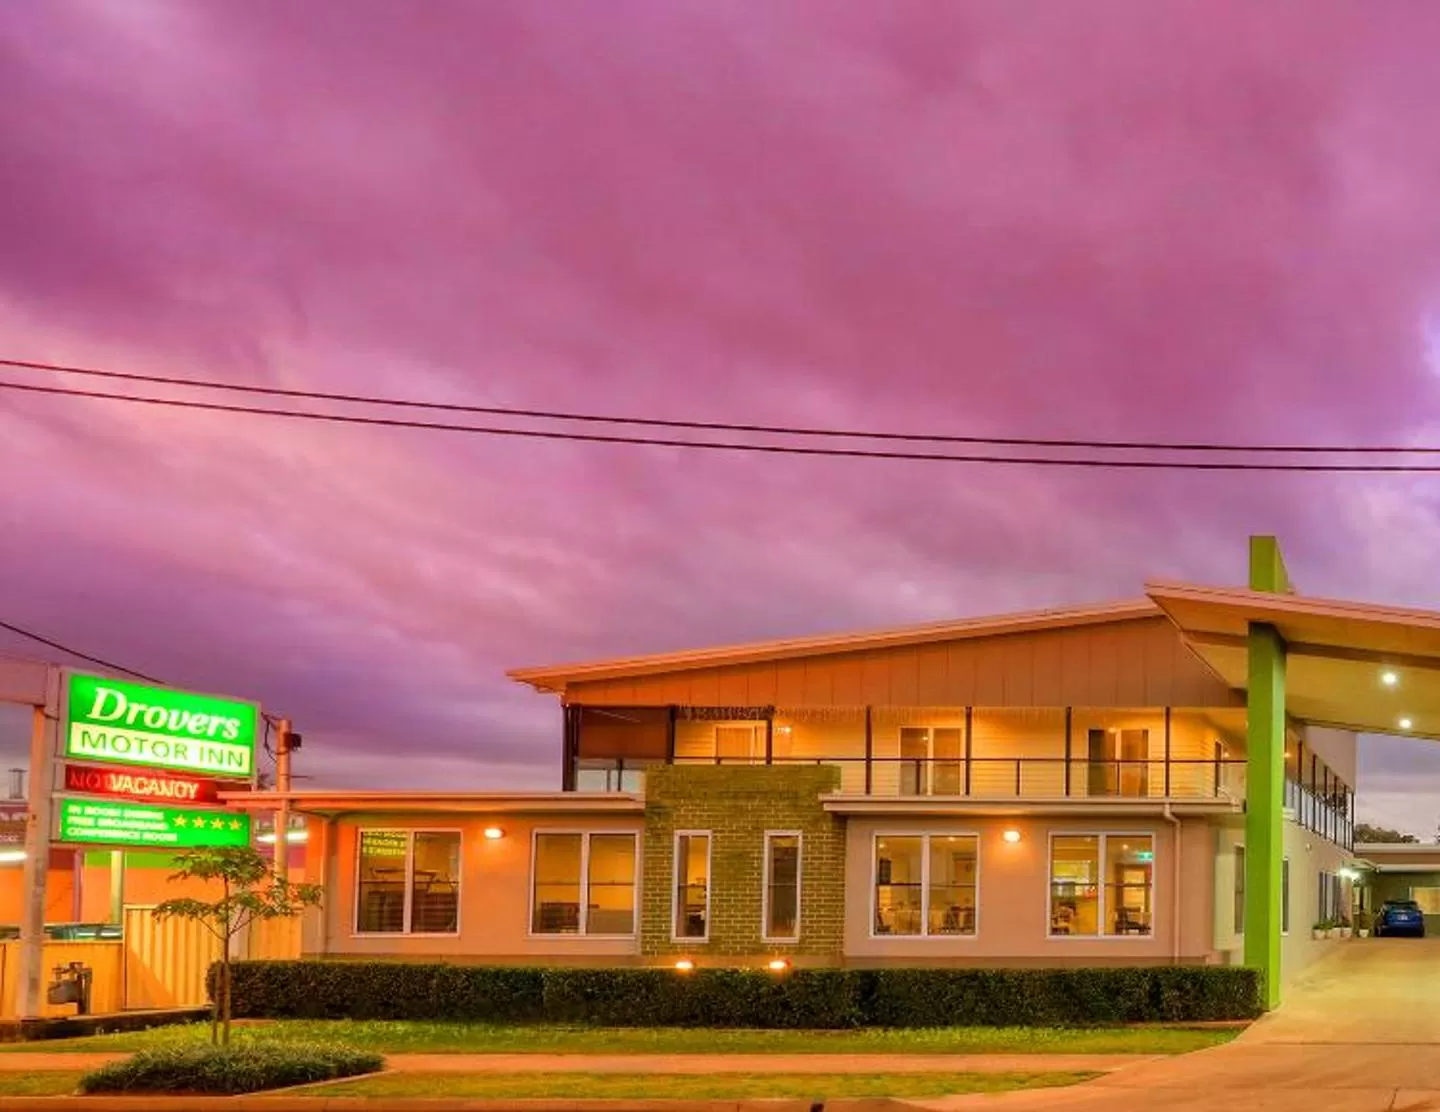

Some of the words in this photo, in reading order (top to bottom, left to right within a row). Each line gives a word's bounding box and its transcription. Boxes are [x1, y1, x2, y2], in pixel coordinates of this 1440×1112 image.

[87, 687, 241, 739] Drovers
[81, 731, 189, 761] MOTOR
[199, 747, 244, 767] INN
[70, 771, 100, 788] NO
[109, 773, 199, 799] VACANCY
